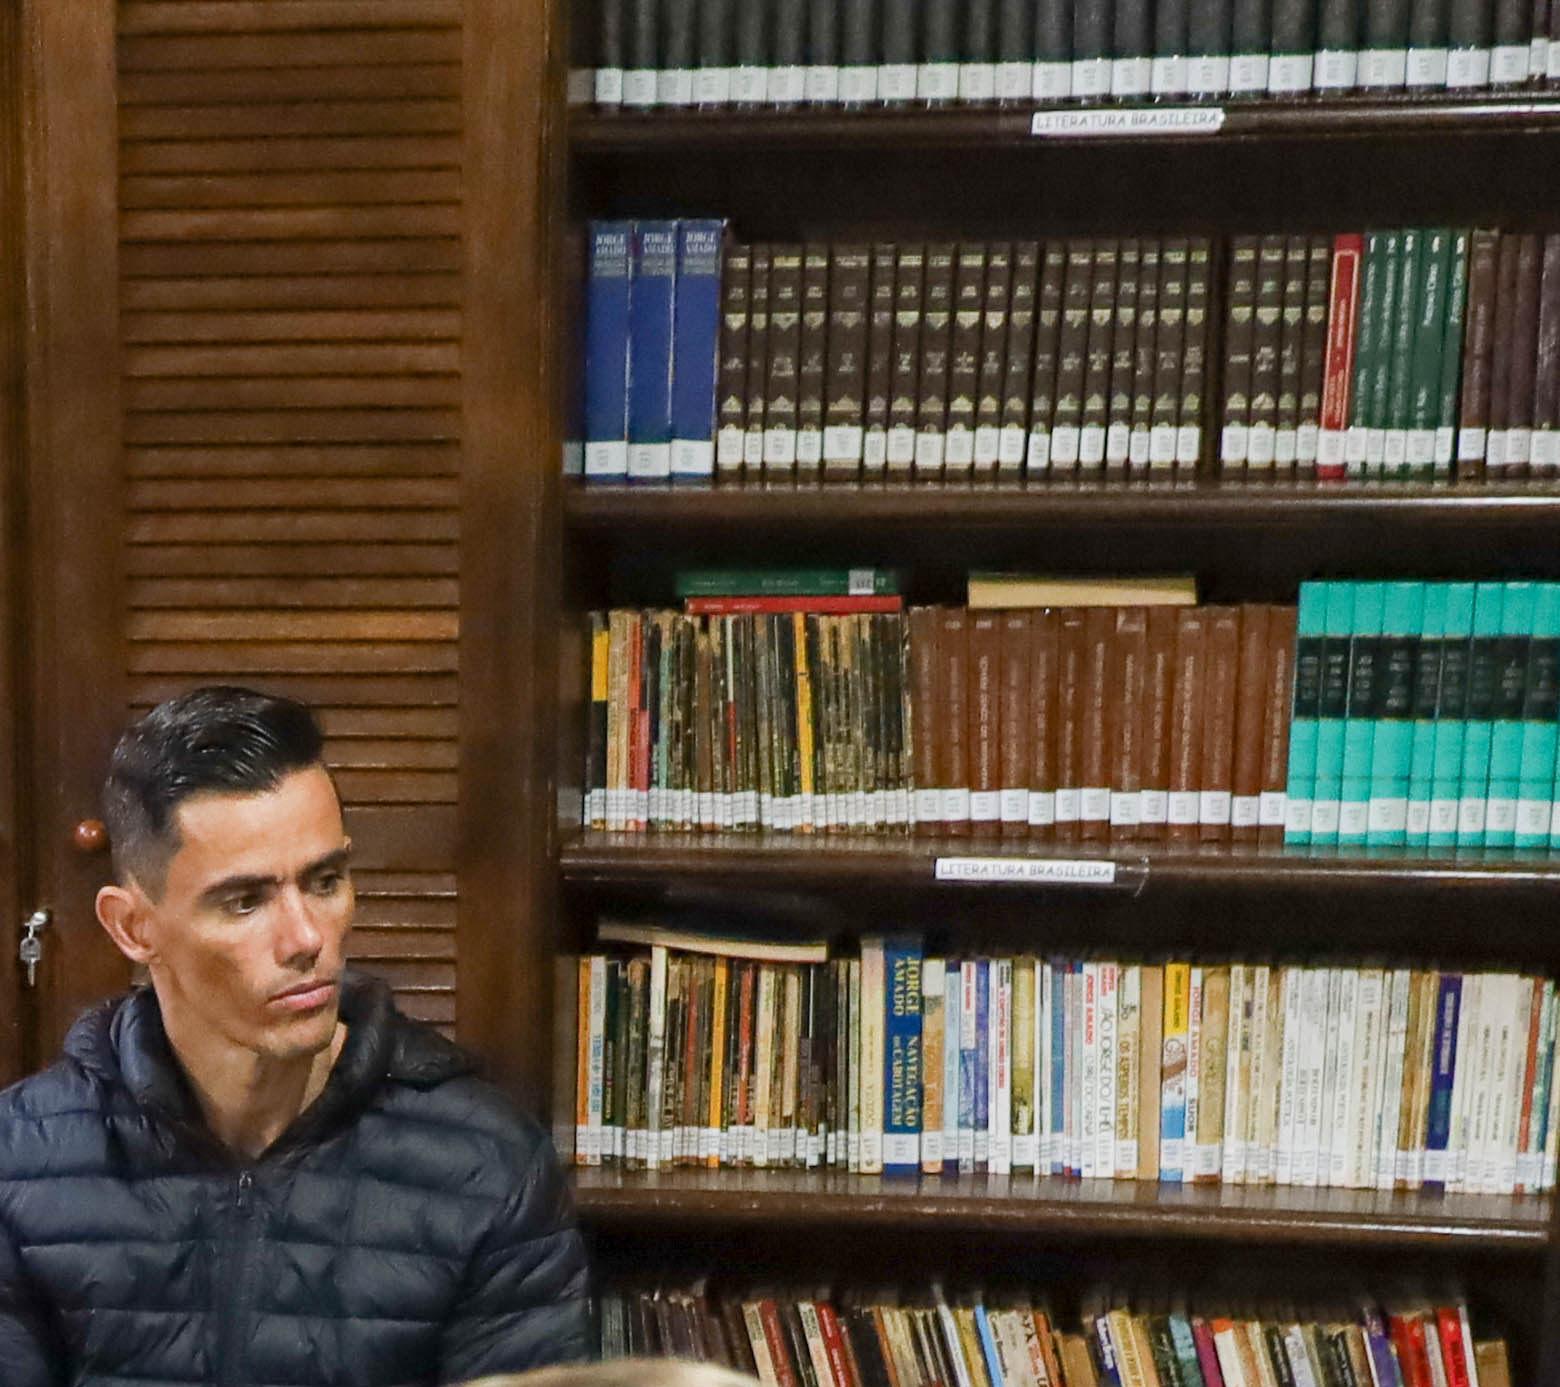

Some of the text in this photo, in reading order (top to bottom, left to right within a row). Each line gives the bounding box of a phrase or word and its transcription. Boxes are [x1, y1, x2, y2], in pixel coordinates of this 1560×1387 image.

[1036, 112, 1217, 130] LITERATURA BRASILEIRA
[940, 863, 1112, 878] LITERATURA BRASILEIRA
[893, 958, 905, 1016] AMADO
[906, 957, 920, 1016] JORGE
[891, 1049, 904, 1125] CABOTAGEM
[905, 1036, 919, 1127] NAVEGAÇÃO
[1187, 986, 1200, 1132] JORGE AMADO SUOR
